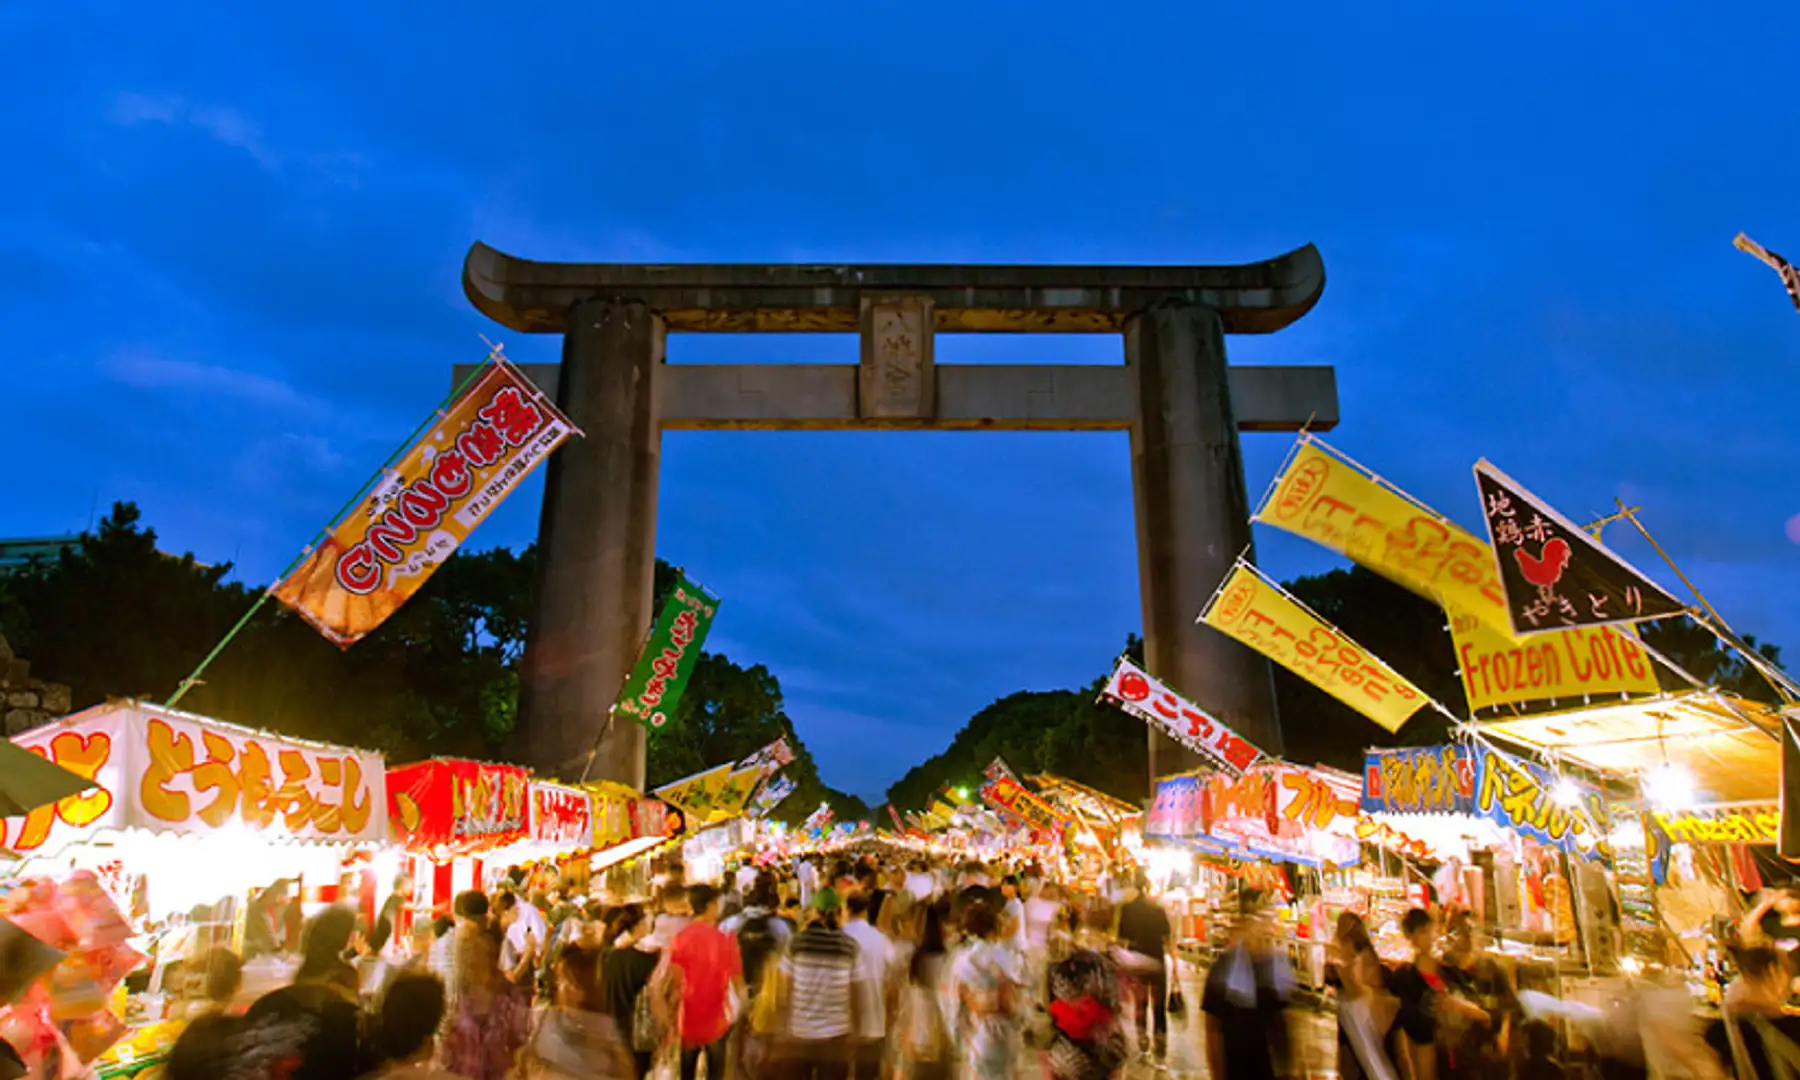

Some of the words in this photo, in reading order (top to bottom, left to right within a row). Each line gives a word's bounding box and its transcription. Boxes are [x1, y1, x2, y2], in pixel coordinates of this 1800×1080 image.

[1521, 585, 1641, 626] やきとり
[1460, 642, 1562, 699] Frozen
